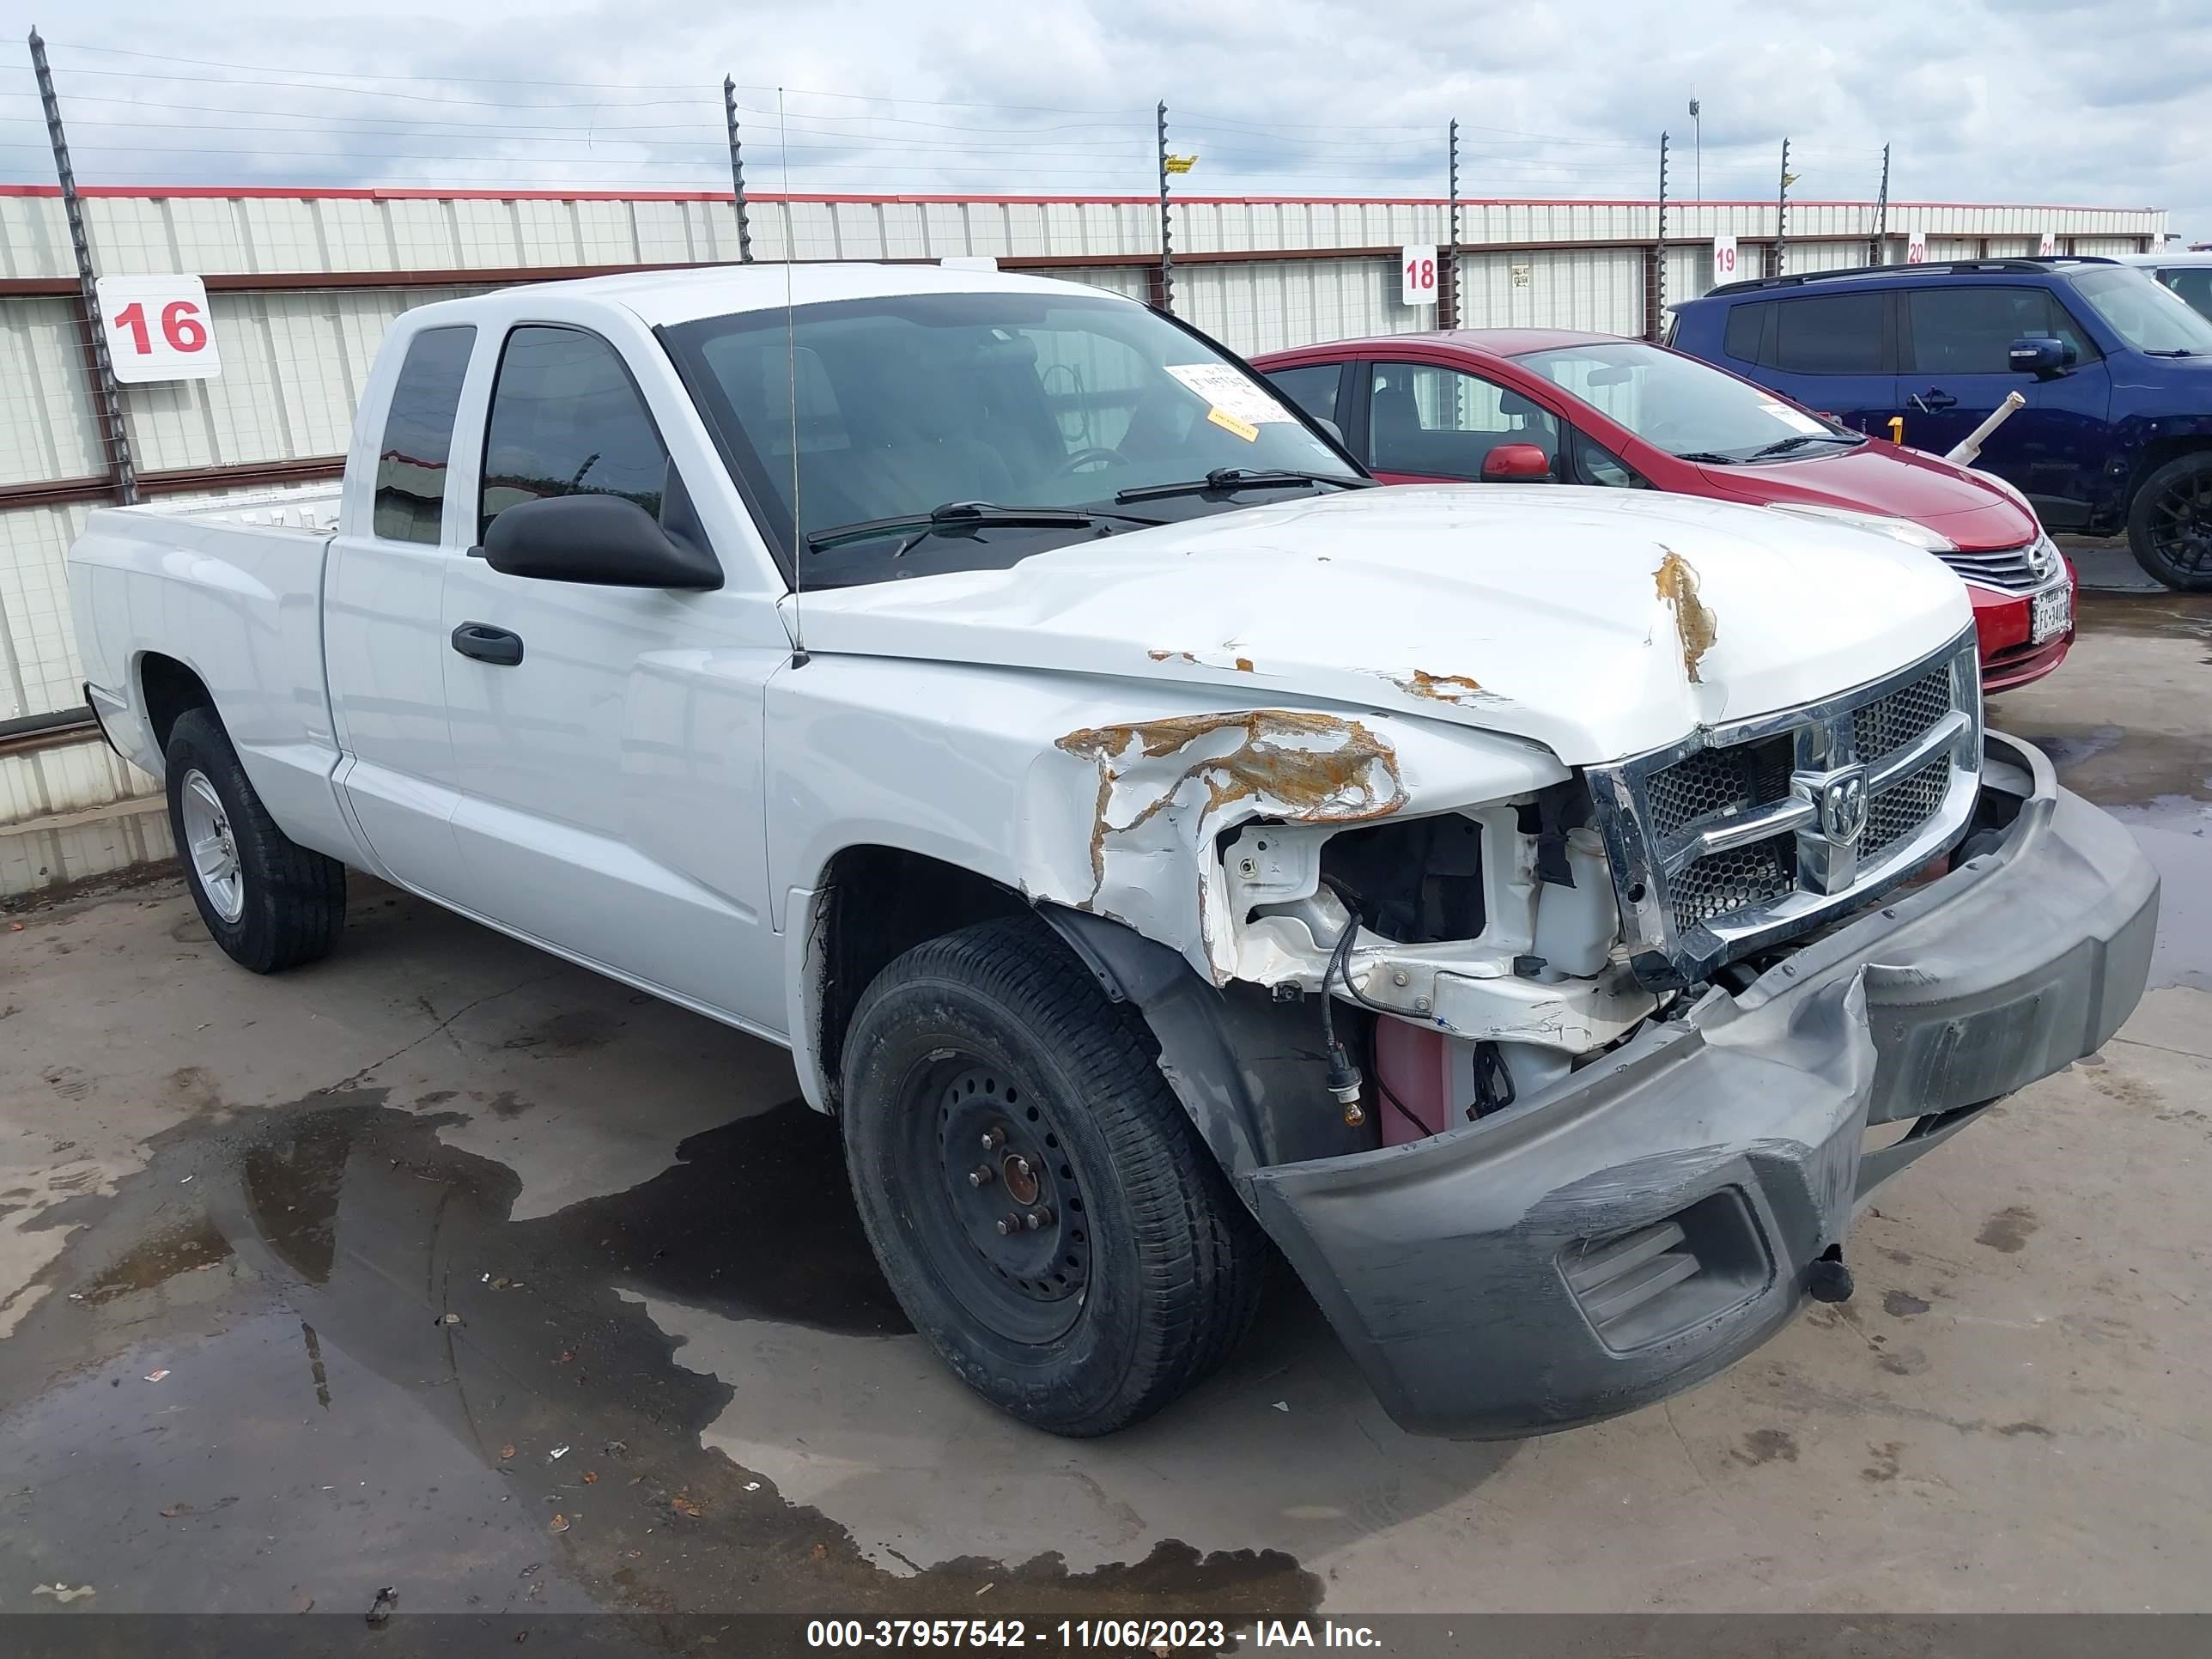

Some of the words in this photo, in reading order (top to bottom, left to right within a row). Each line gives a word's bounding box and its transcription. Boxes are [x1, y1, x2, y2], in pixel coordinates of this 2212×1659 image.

[1717, 248, 1735, 271] 19
[1909, 243, 1923, 263] 20
[1407, 259, 1434, 289] 18
[114, 301, 207, 355] 16
[2045, 592, 2059, 605] TEXAS
